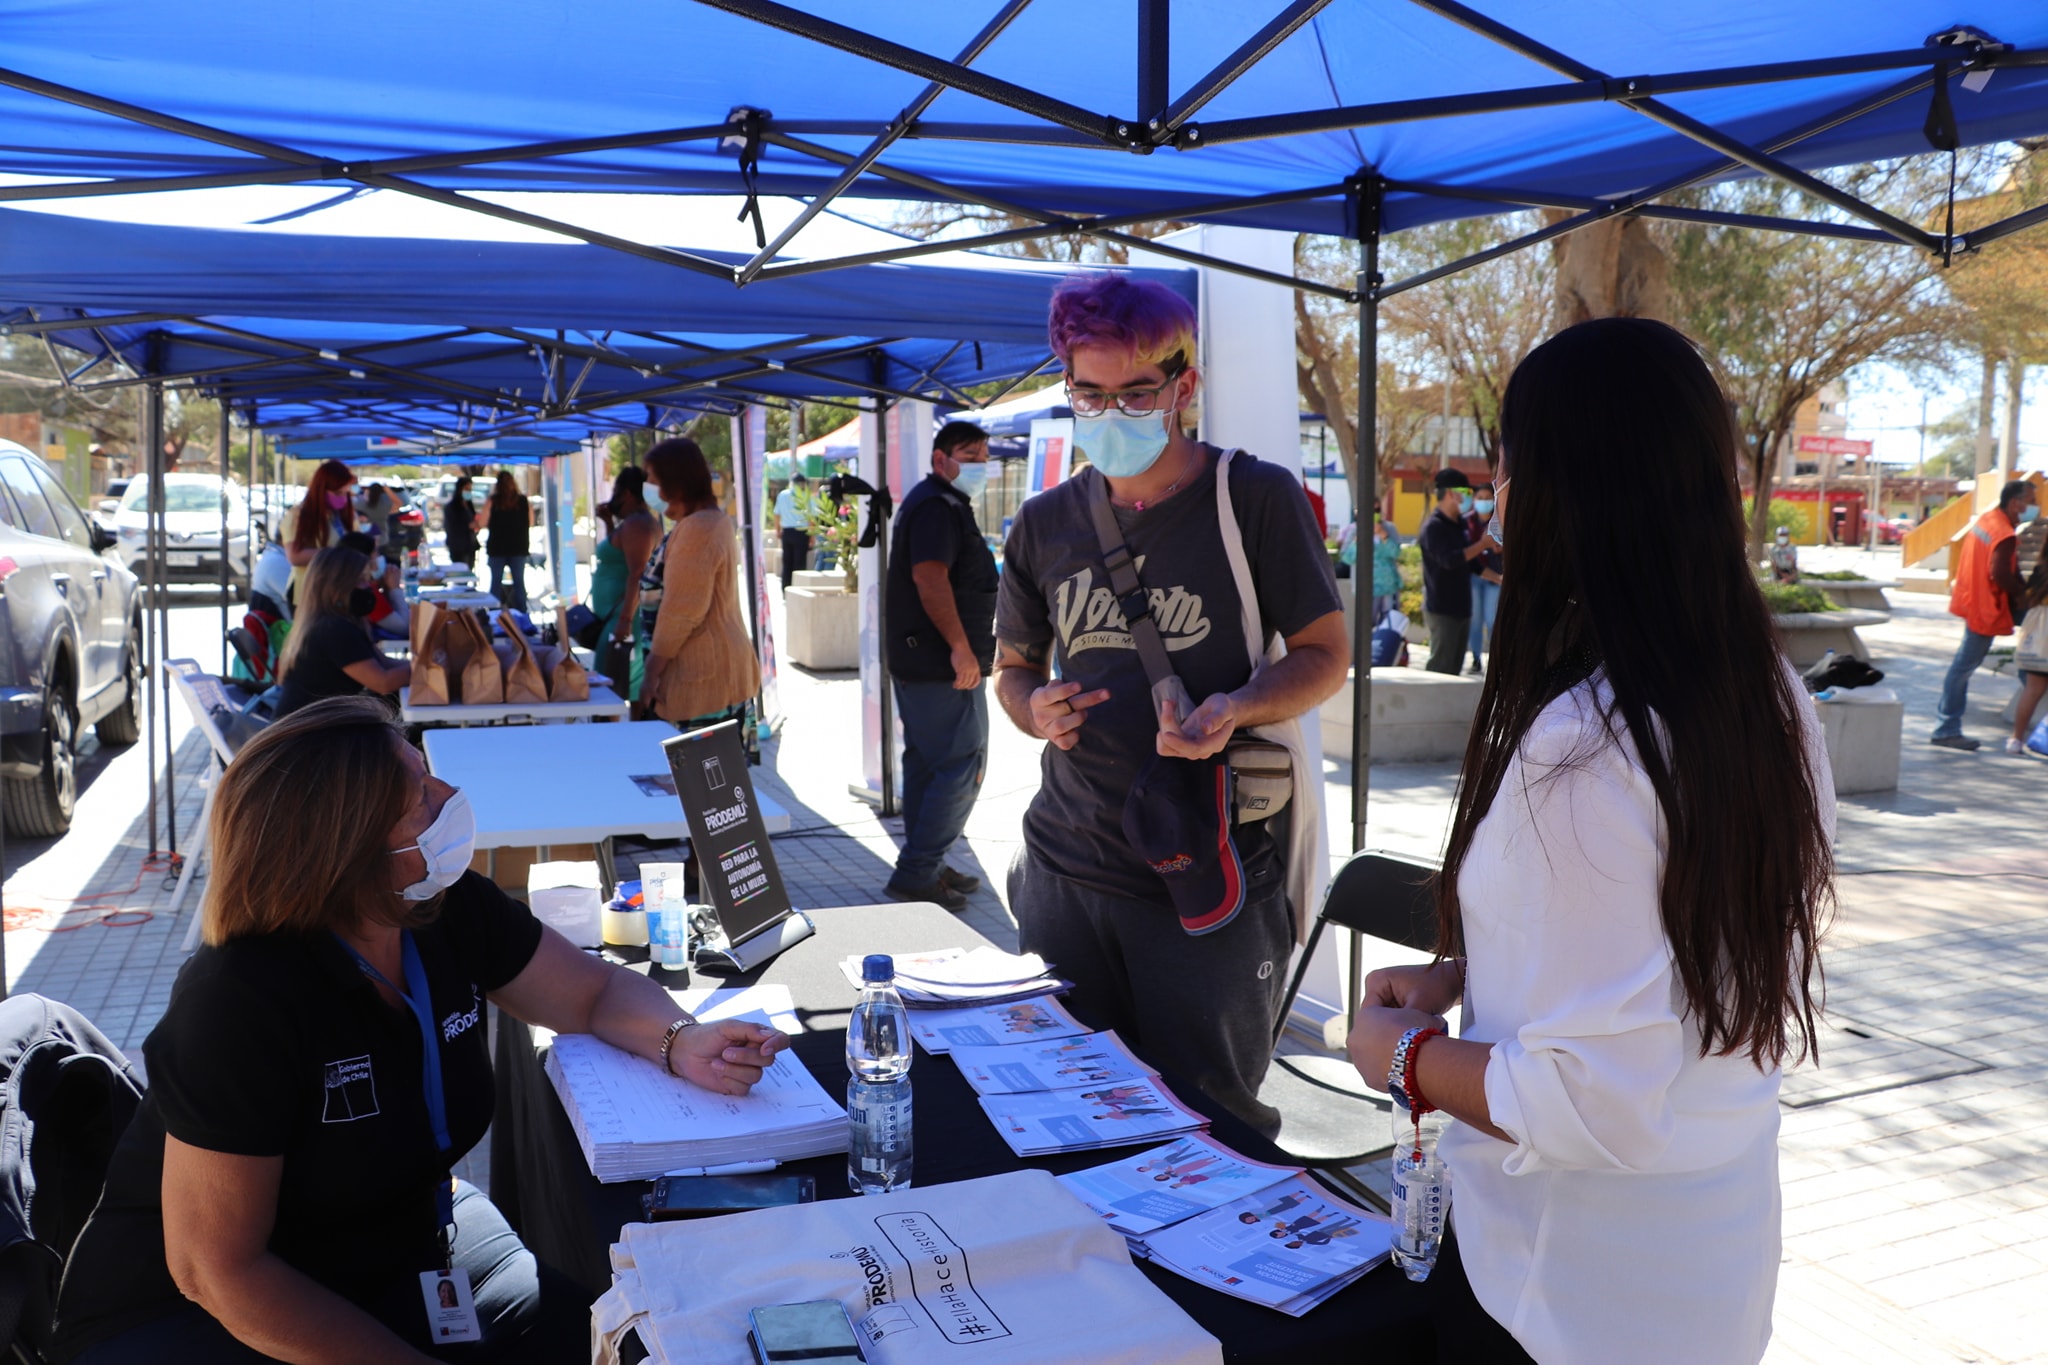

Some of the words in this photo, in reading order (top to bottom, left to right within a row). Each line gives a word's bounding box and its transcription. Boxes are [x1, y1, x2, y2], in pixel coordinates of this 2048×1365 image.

[1055, 555, 1212, 648] Volom
[1081, 634, 1112, 645] STONE
[721, 859, 734, 872] RED
[733, 853, 750, 867] PARA
[748, 847, 758, 860] LA
[728, 859, 763, 885] AUTONOMÍA
[730, 885, 741, 899] DE
[738, 881, 748, 895] LA
[747, 873, 768, 891] MUJER
[444, 1009, 478, 1042] PRODE
[339, 1062, 370, 1073] Gobierno
[340, 1075, 350, 1083] de
[351, 1071, 369, 1081] Chile
[901, 1217, 992, 1336] #EllaHaceHistoria
